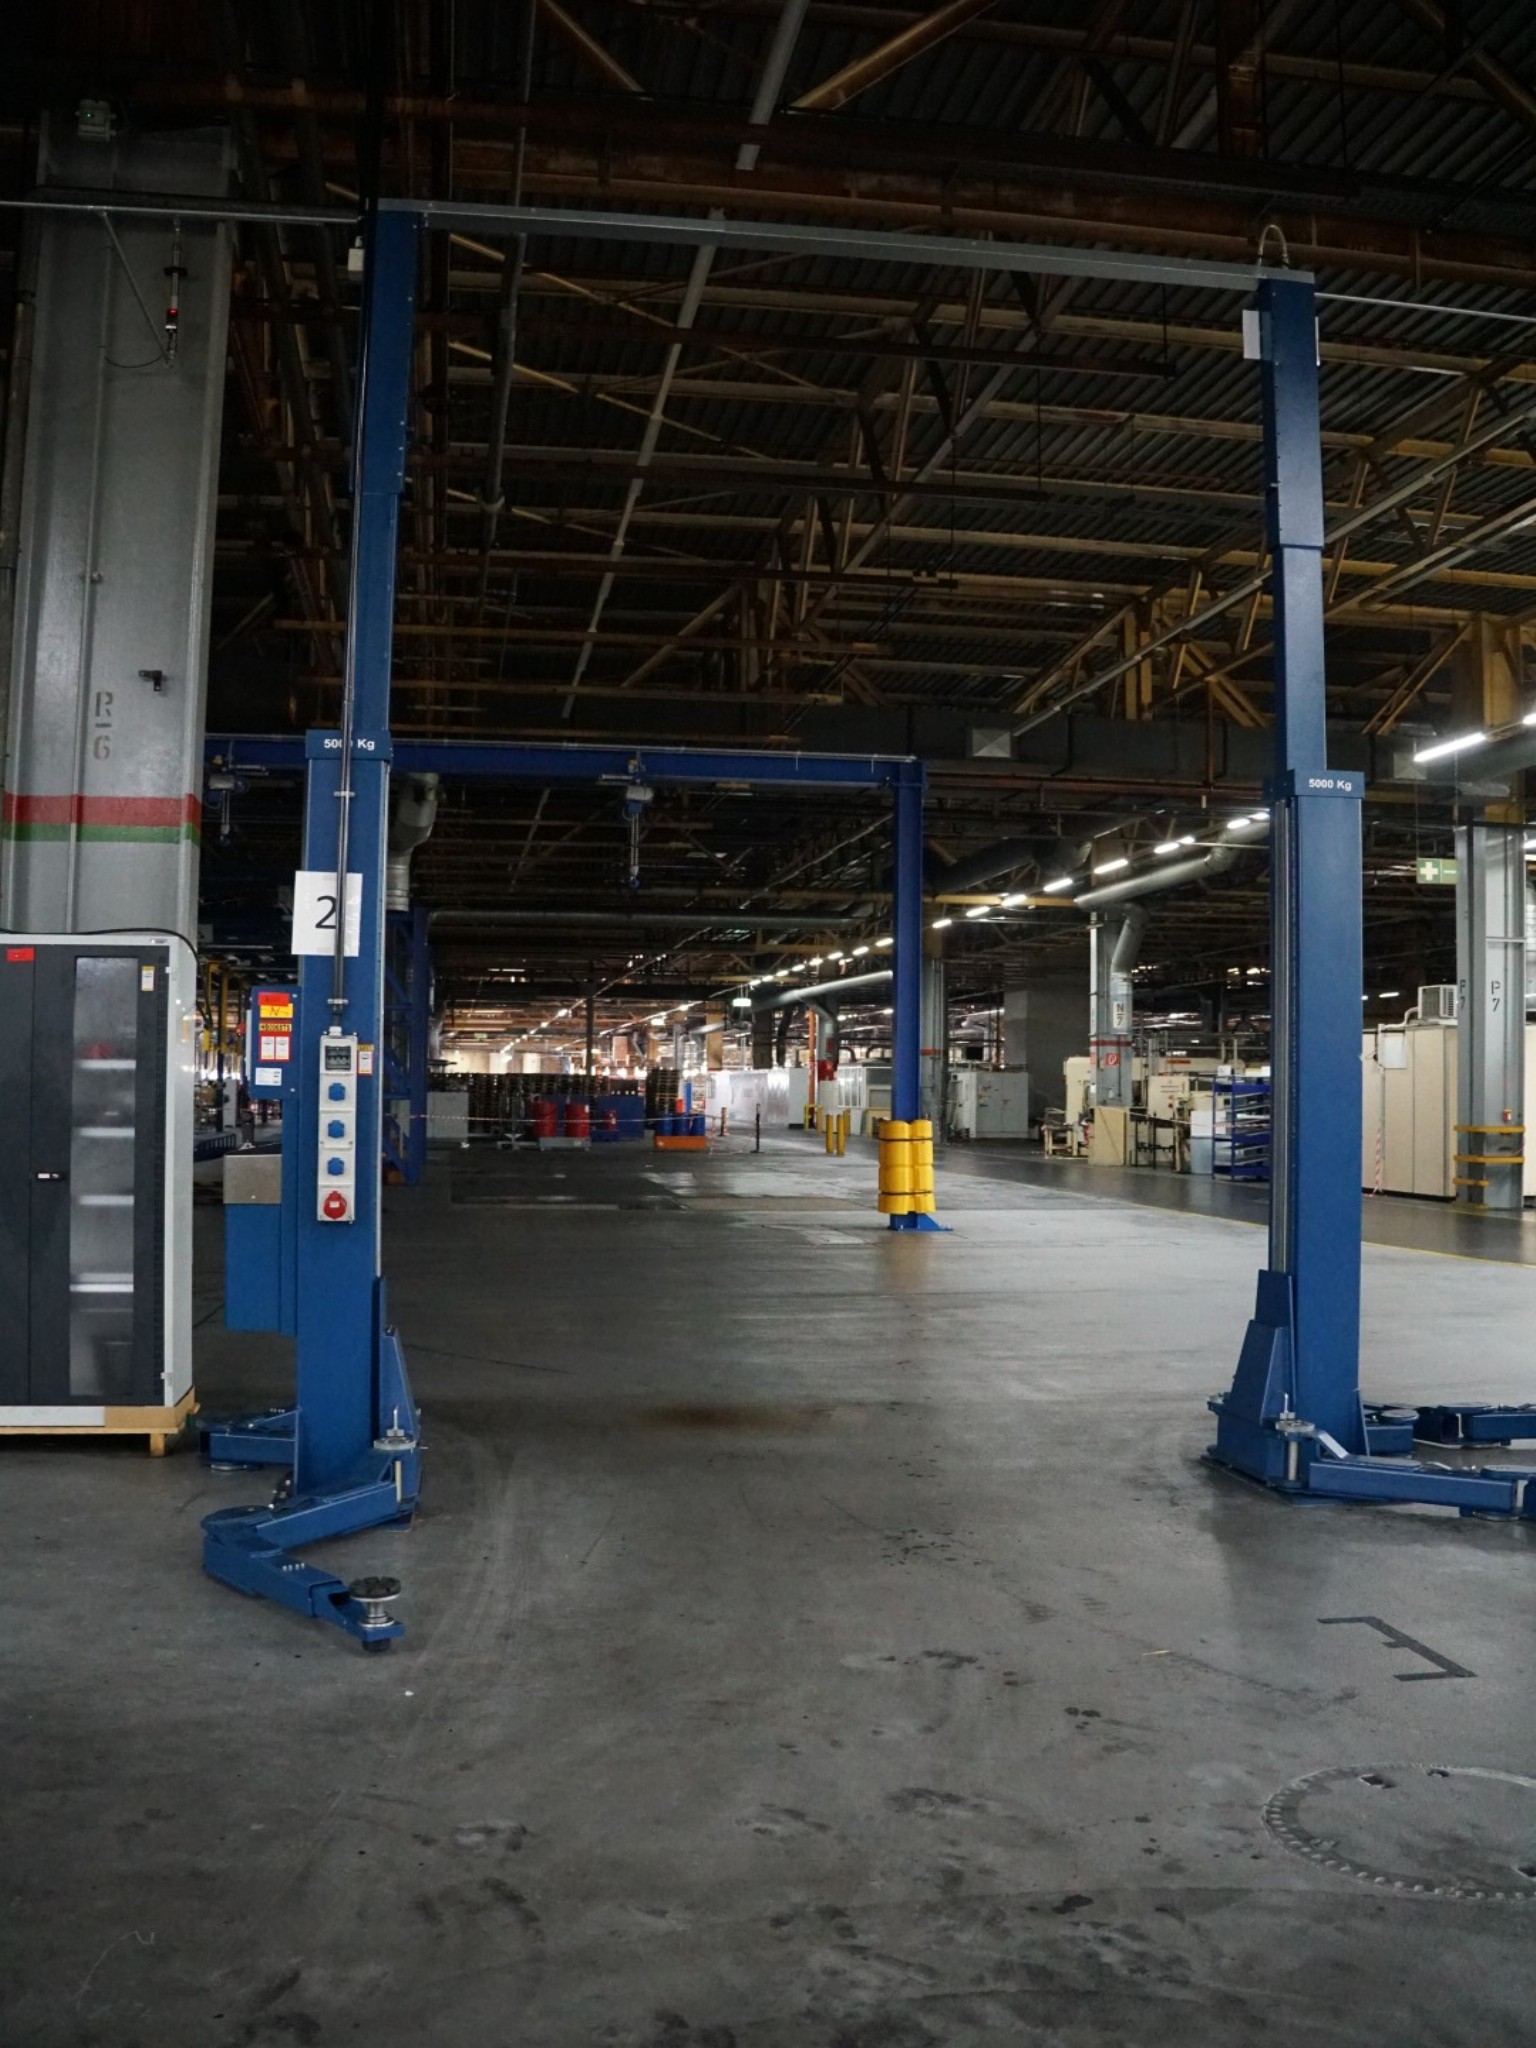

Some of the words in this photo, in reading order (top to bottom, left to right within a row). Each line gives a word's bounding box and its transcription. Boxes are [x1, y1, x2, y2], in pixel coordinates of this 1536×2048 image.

[95, 691, 113, 717] R
[324, 739, 354, 749] 50
[357, 739, 376, 752] Kg
[1308, 778, 1334, 788] 5000
[1337, 780, 1352, 791] Kg
[315, 895, 338, 930] 2
[1491, 981, 1501, 995] P
[1492, 998, 1501, 1012] 7
